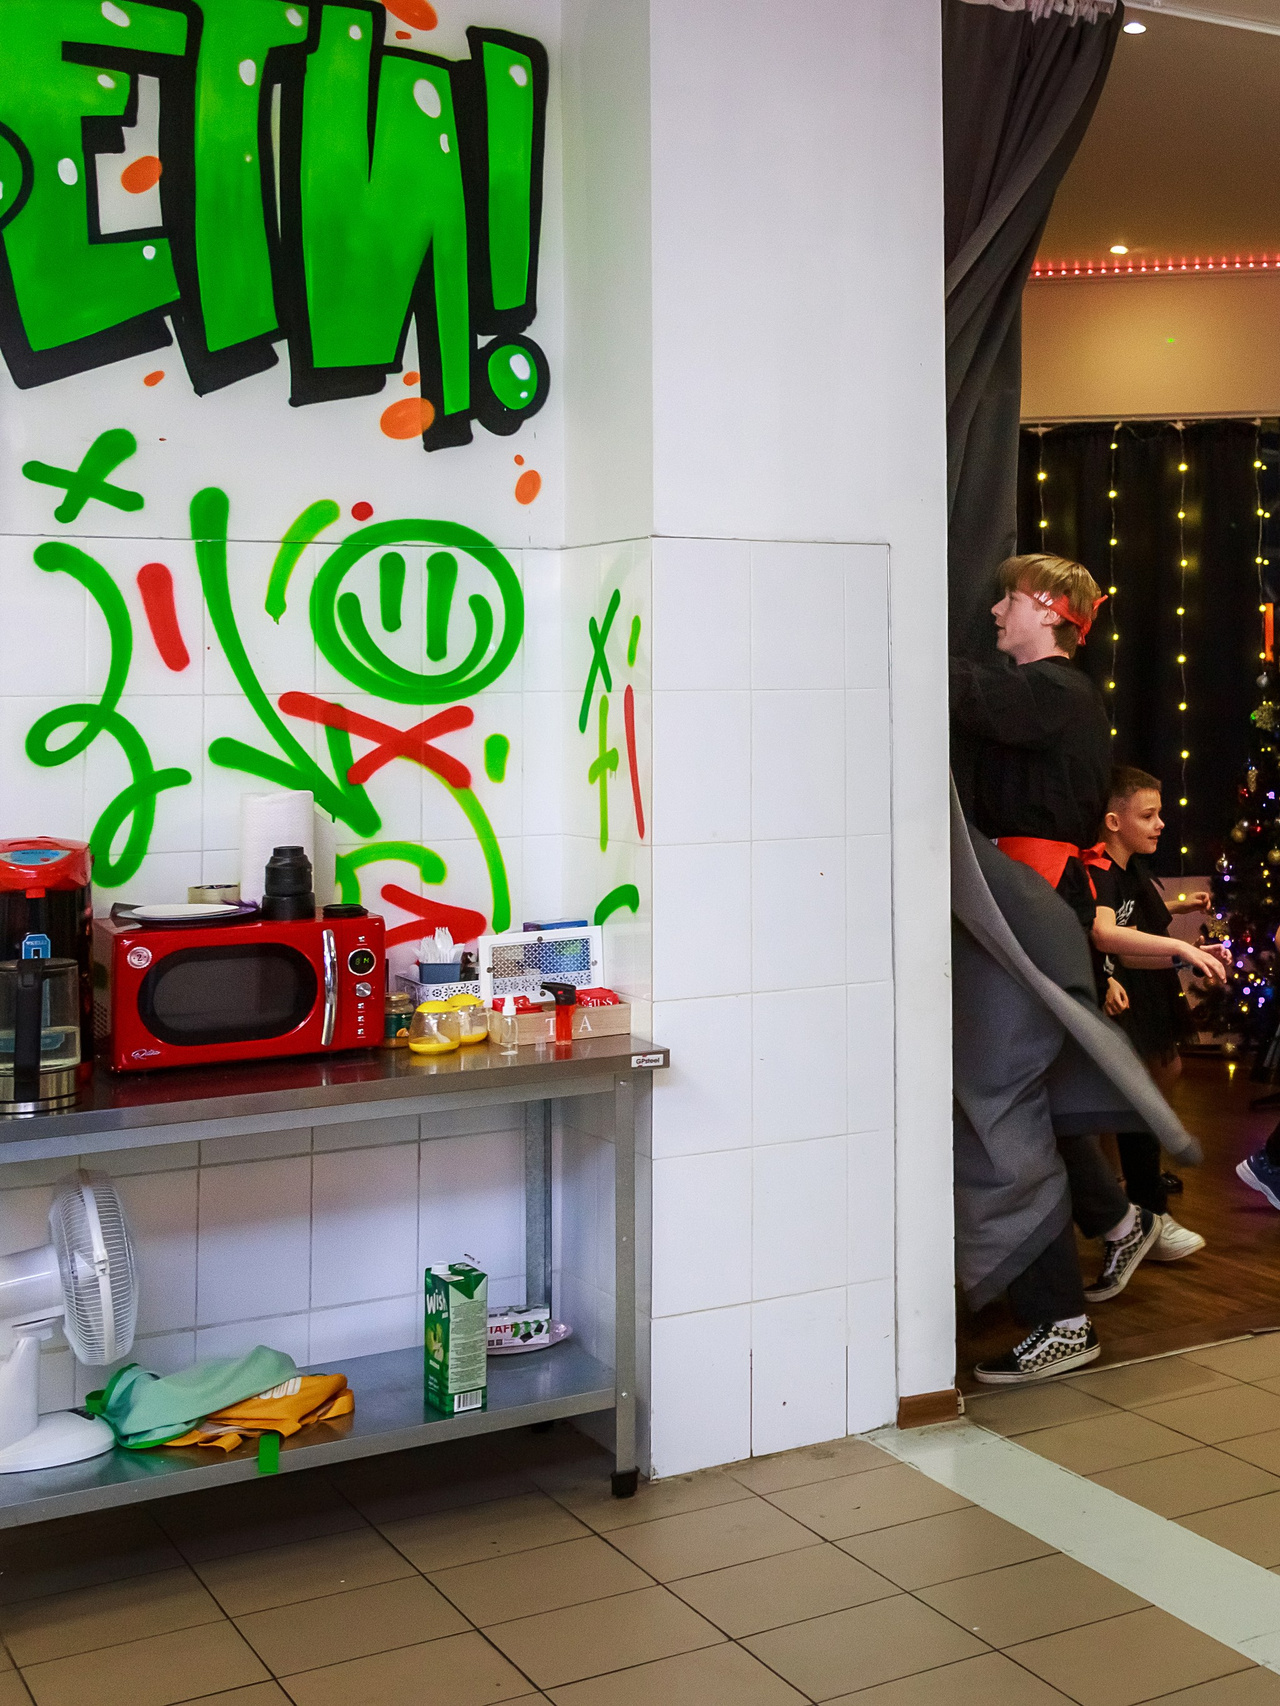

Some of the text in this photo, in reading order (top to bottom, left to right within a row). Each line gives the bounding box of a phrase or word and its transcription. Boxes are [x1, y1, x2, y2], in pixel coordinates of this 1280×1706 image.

[0, 0, 550, 450] ЕТИ!
[545, 1014, 593, 1036] TA
[426, 1288, 448, 1314] Wish
